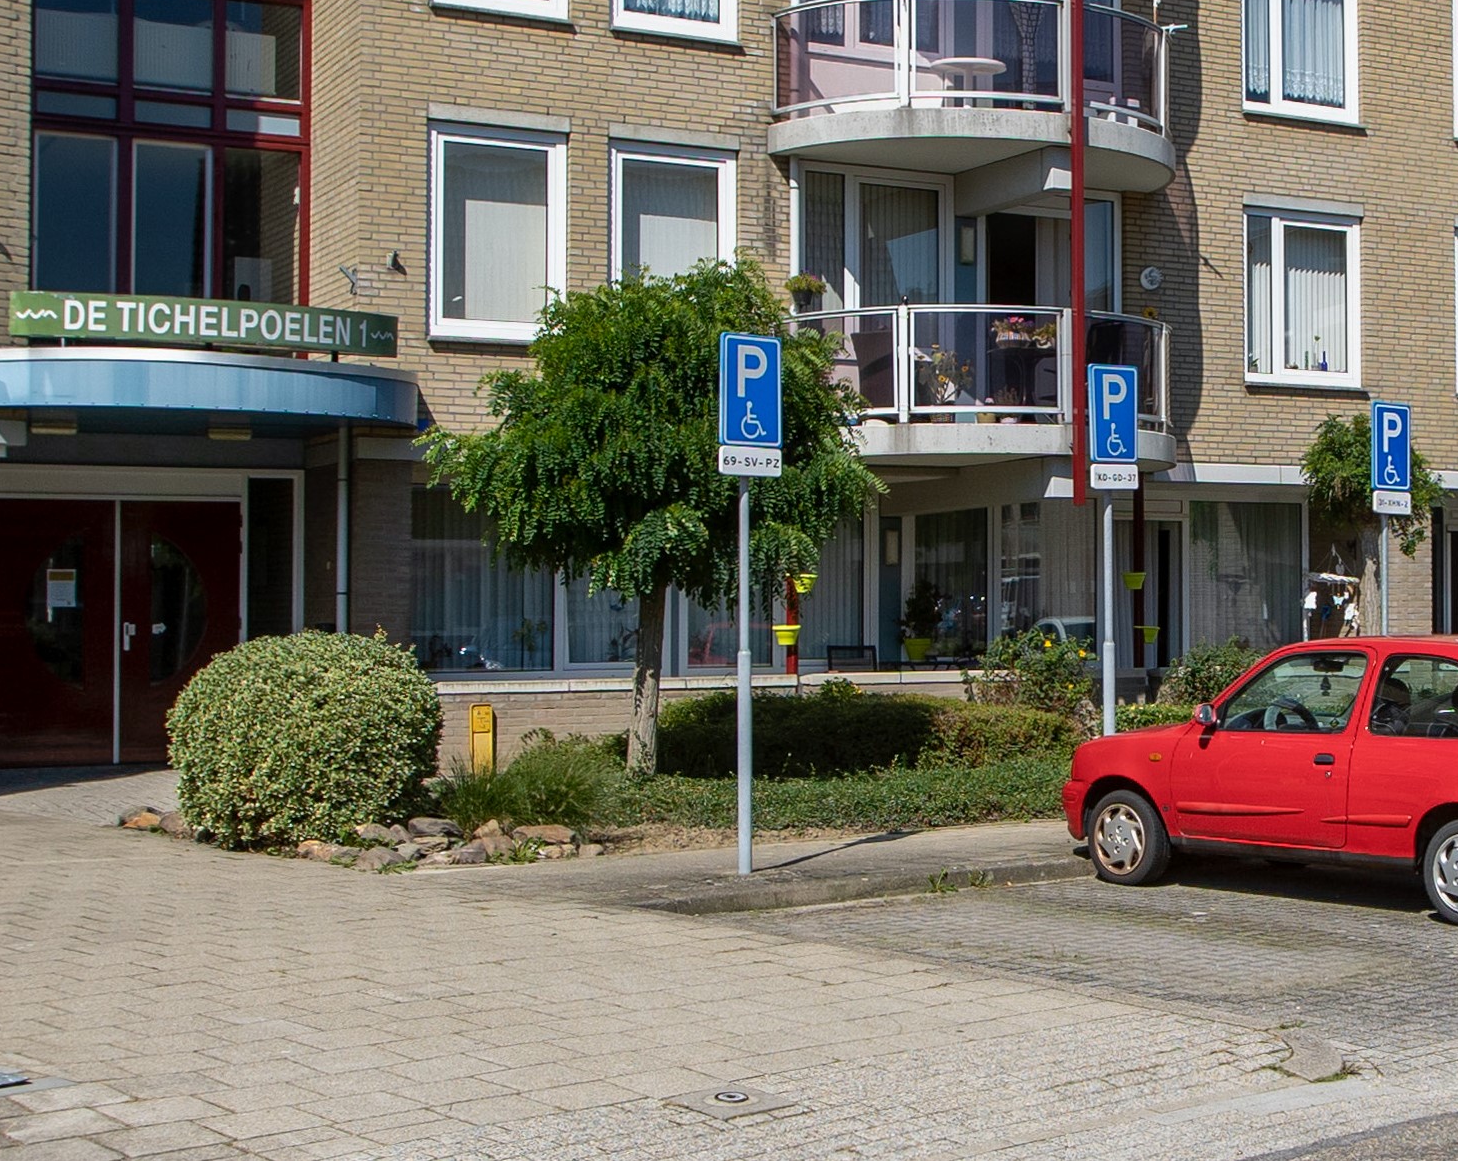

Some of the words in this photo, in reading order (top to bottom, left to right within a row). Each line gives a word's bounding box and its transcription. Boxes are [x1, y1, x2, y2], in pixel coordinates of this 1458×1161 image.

[63, 299, 107, 331] DE
[116, 301, 351, 346] TICHELPOELEN
[359, 319, 367, 348] 1
[737, 344, 767, 398] P
[1102, 373, 1128, 420] P
[1383, 412, 1402, 453] P
[723, 455, 780, 469] 69-SV-PZ
